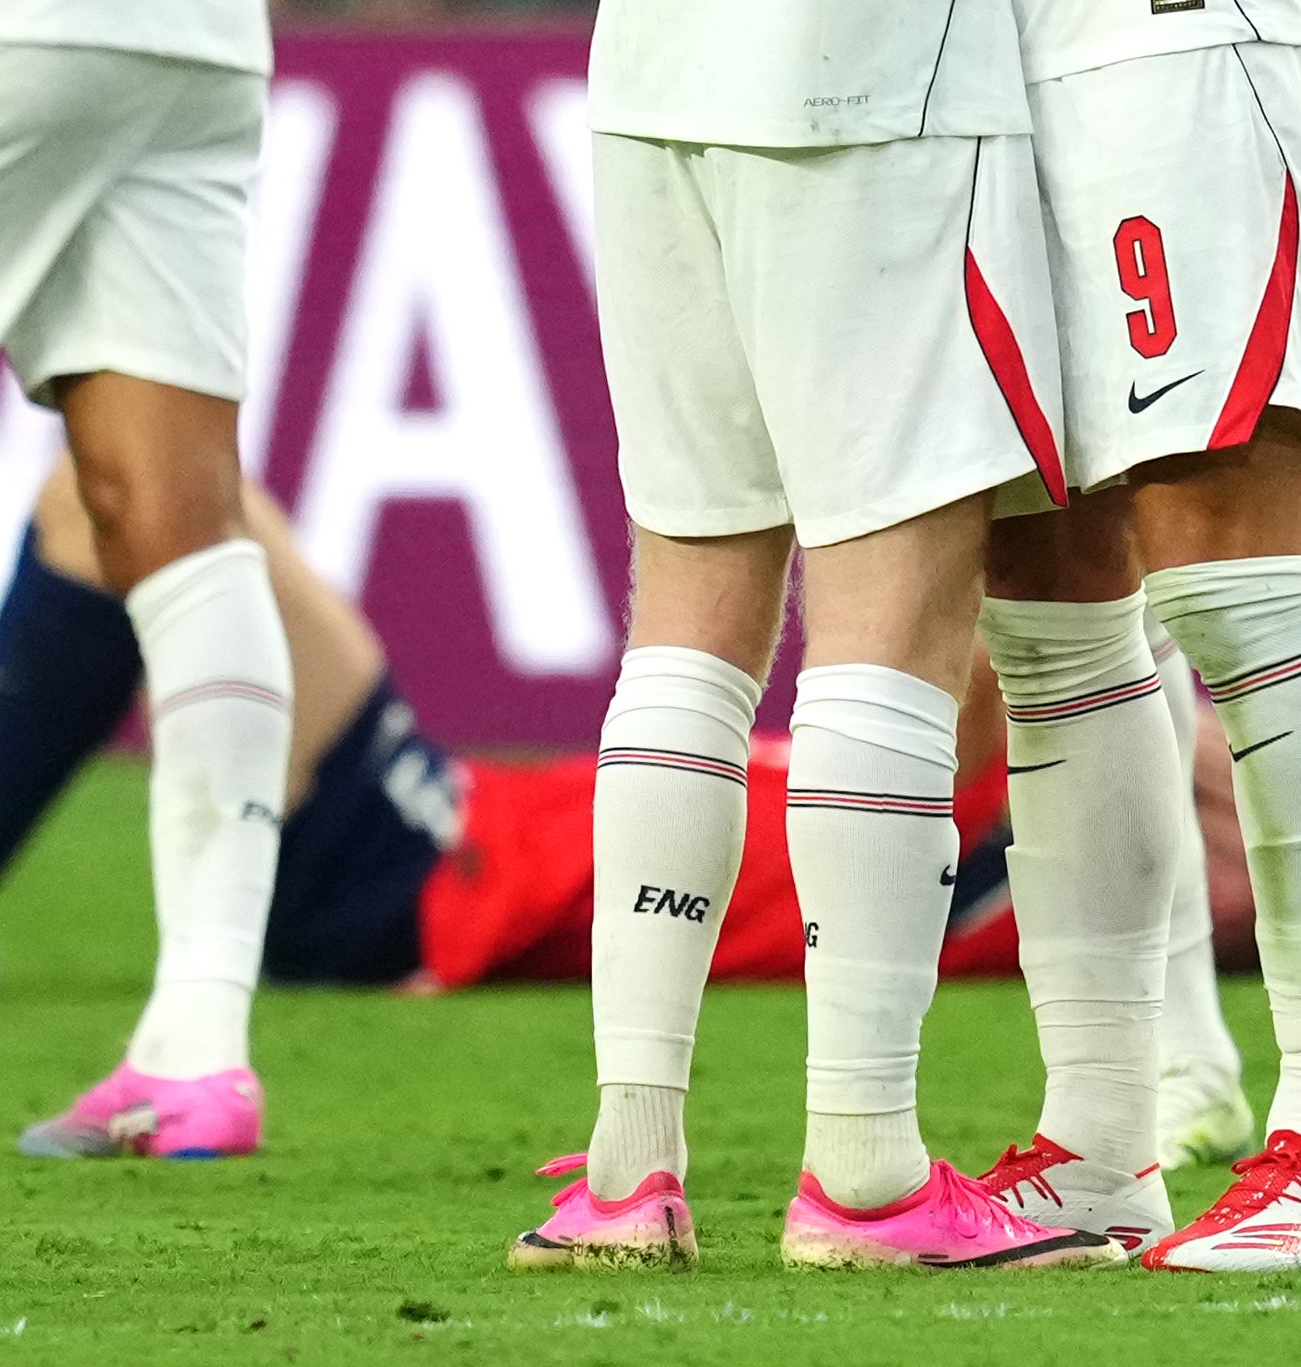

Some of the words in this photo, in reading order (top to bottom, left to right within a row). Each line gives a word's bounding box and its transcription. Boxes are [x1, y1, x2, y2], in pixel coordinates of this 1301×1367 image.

[803, 94, 872, 107] AERO-FIT
[1113, 214, 1177, 359] 9
[633, 884, 710, 923] ENG
